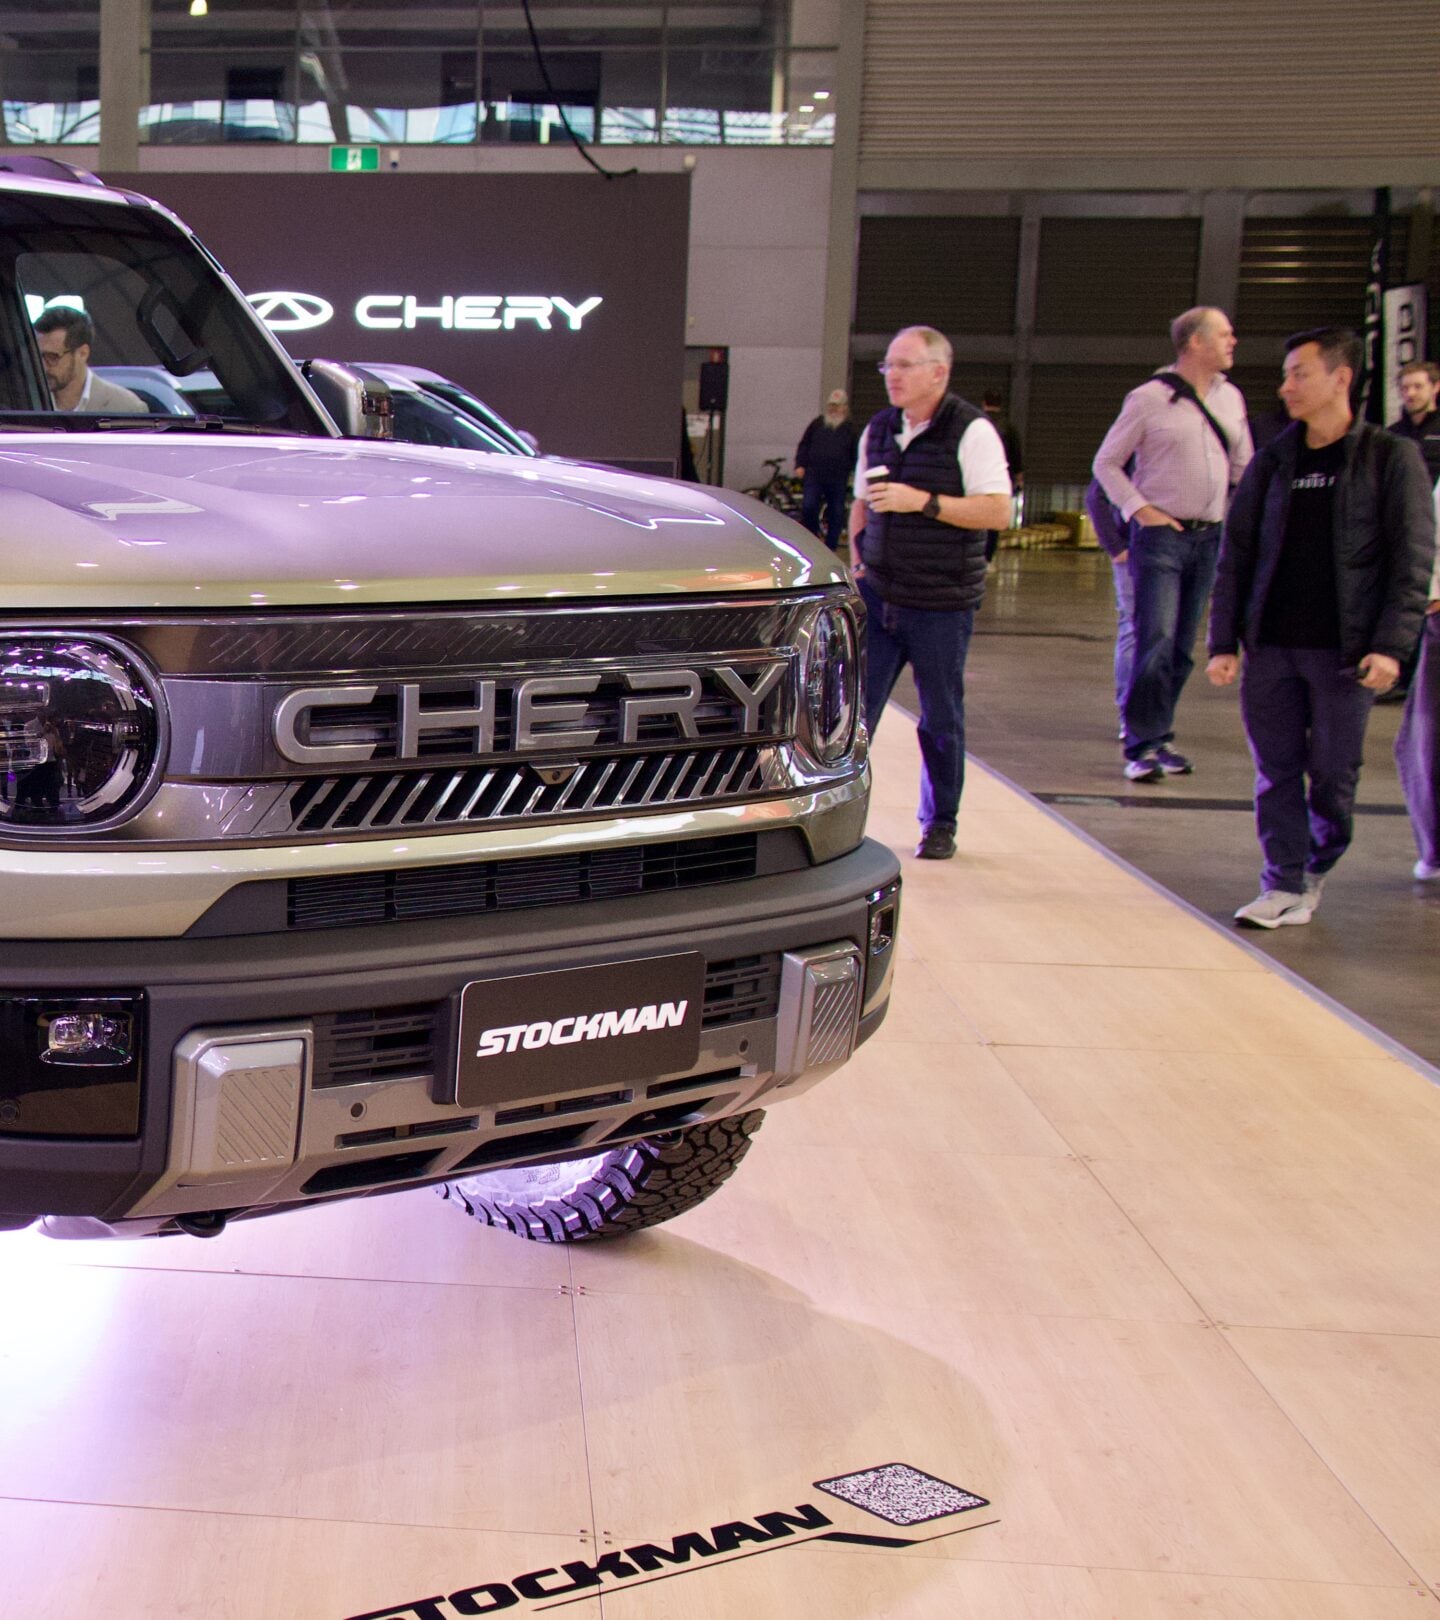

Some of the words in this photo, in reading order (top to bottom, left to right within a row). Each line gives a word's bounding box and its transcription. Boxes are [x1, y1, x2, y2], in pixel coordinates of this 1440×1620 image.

[355, 295, 604, 330] CHERY
[272, 662, 790, 764] CHERY
[476, 1000, 688, 1057] STOCKMAN
